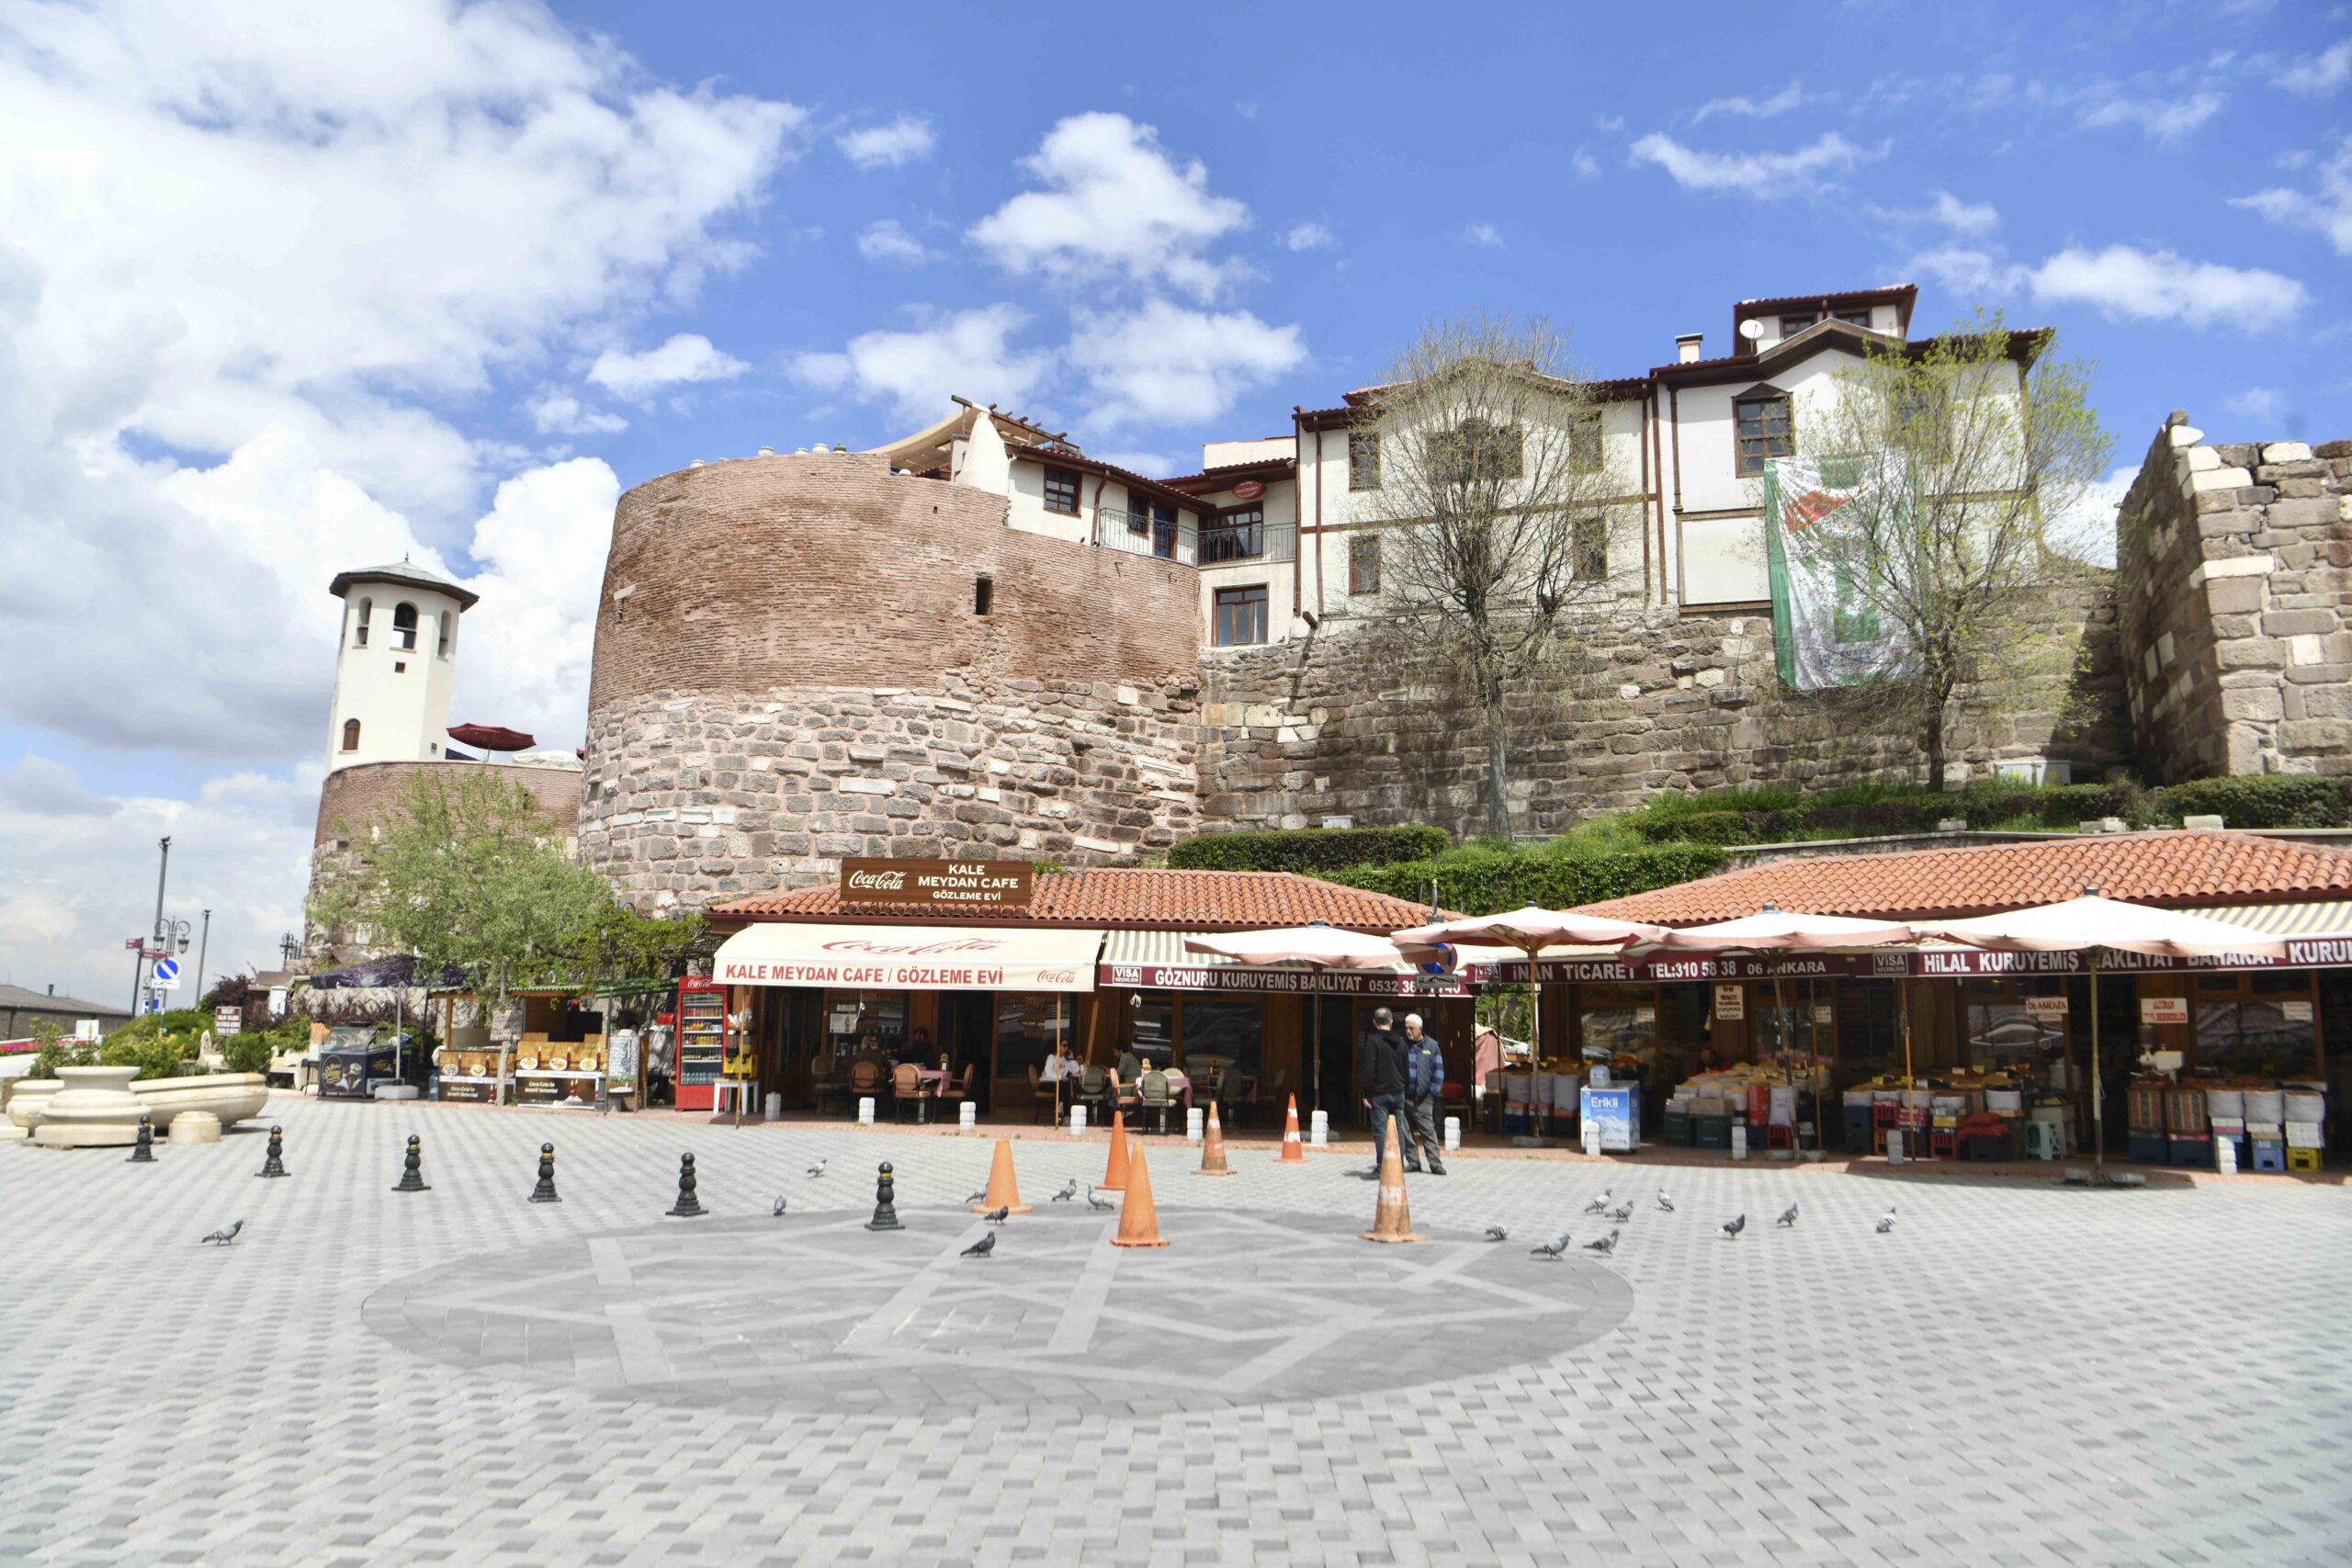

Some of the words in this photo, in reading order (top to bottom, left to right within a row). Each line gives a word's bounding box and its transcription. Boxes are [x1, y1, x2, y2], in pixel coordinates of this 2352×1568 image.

[948, 864, 986, 875] KALE
[849, 870, 907, 890] Coca-Cola
[918, 876, 978, 888] MEYDAN
[980, 877, 1019, 889] CAFE
[933, 890, 982, 901] GÖZLEME
[984, 891, 1001, 901] EVİ
[2098, 949, 2174, 969] AKLYA
[725, 964, 768, 979] KALE
[772, 965, 837, 981] MEYDAN
[842, 967, 884, 983] CAFE
[897, 965, 973, 985] GÖZLEME
[978, 966, 1003, 985] EVİ
[1702, 961, 1717, 977] 58
[1721, 960, 1736, 976] 38
[1747, 963, 1763, 975] 06
[1155, 967, 1218, 987] GÖZNURU
[1222, 970, 1297, 991] KURUYEMİŞ
[1300, 972, 1363, 991] BAKLİYAT
[1369, 980, 1398, 992] 0532
